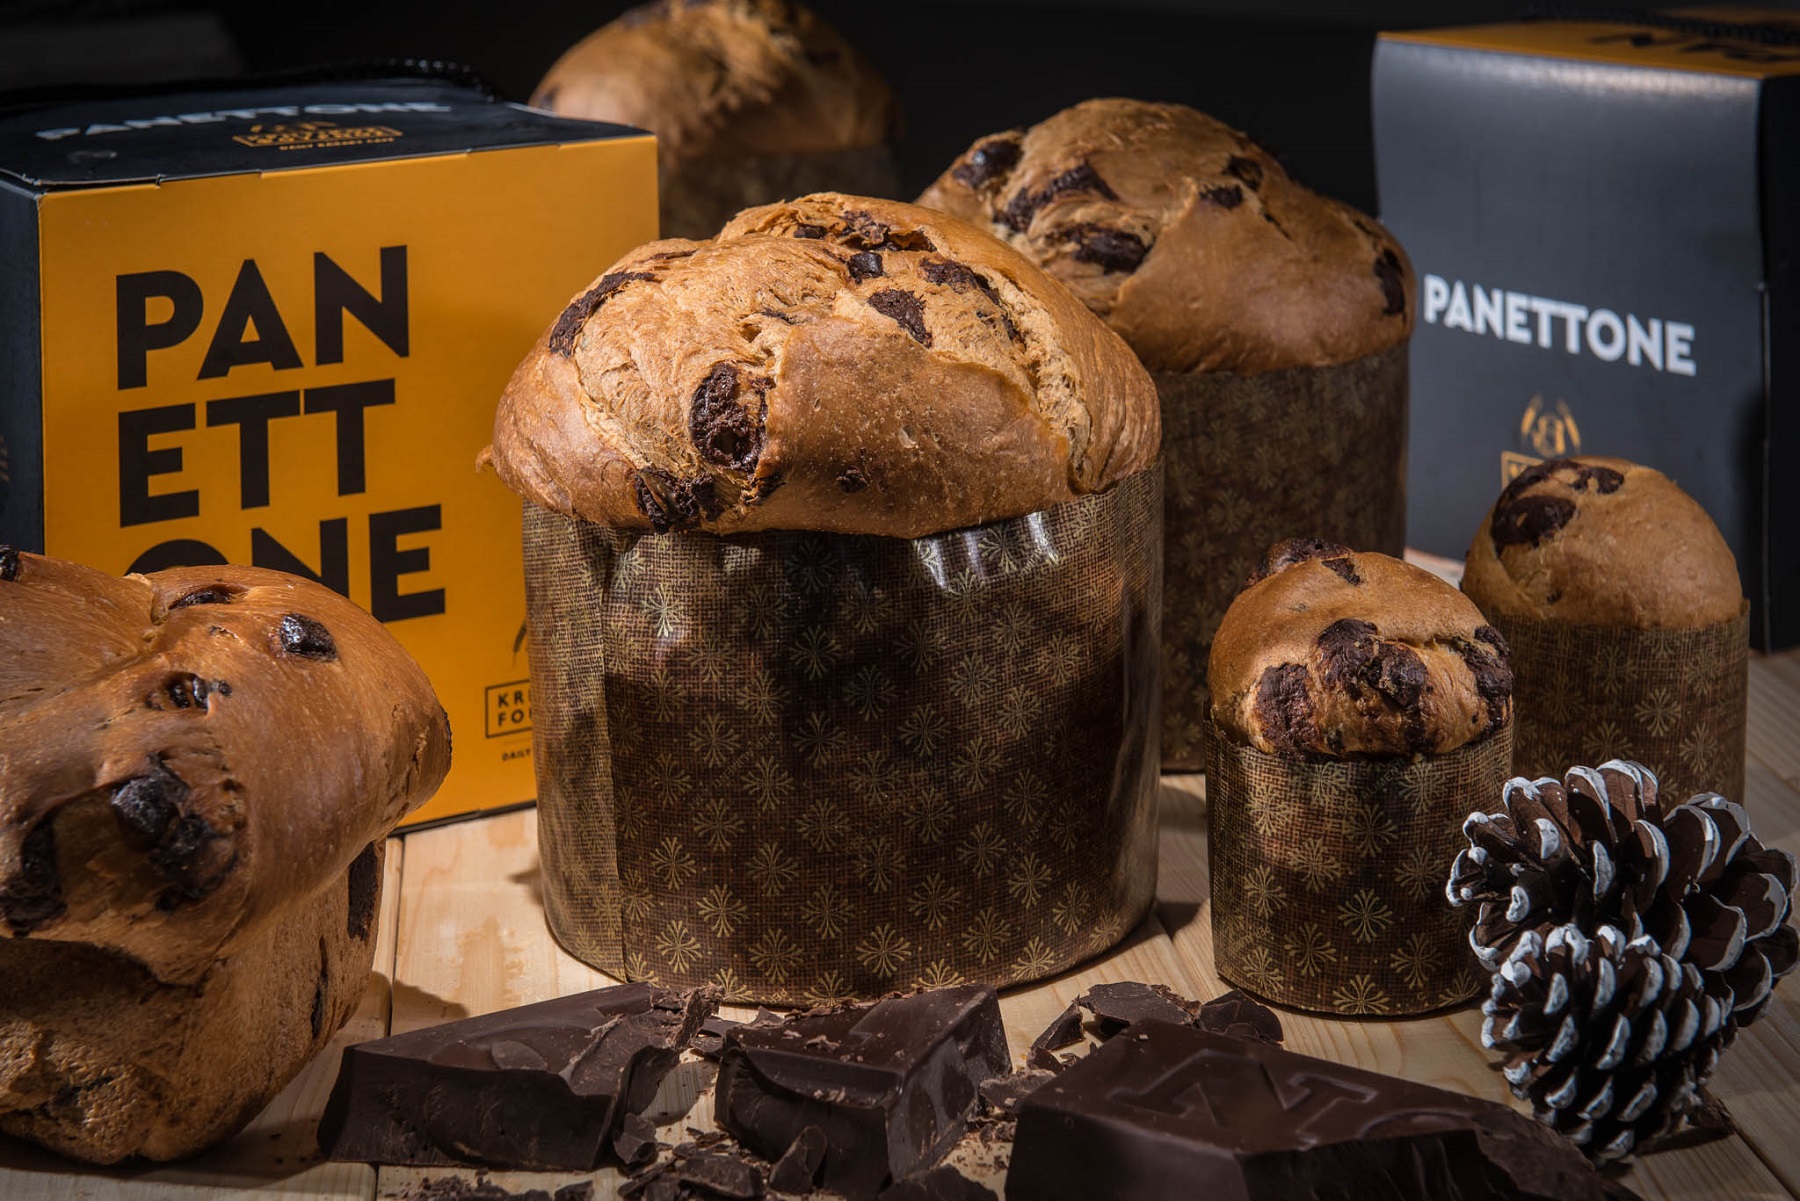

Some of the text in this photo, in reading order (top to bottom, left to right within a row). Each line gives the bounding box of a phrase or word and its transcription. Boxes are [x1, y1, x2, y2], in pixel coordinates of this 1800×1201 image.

[116, 245, 410, 391] PAN
[1423, 275, 1697, 376] PANETTONE
[118, 378, 396, 528] ETT
[498, 690, 531, 708] KR
[498, 709, 532, 726] FO
